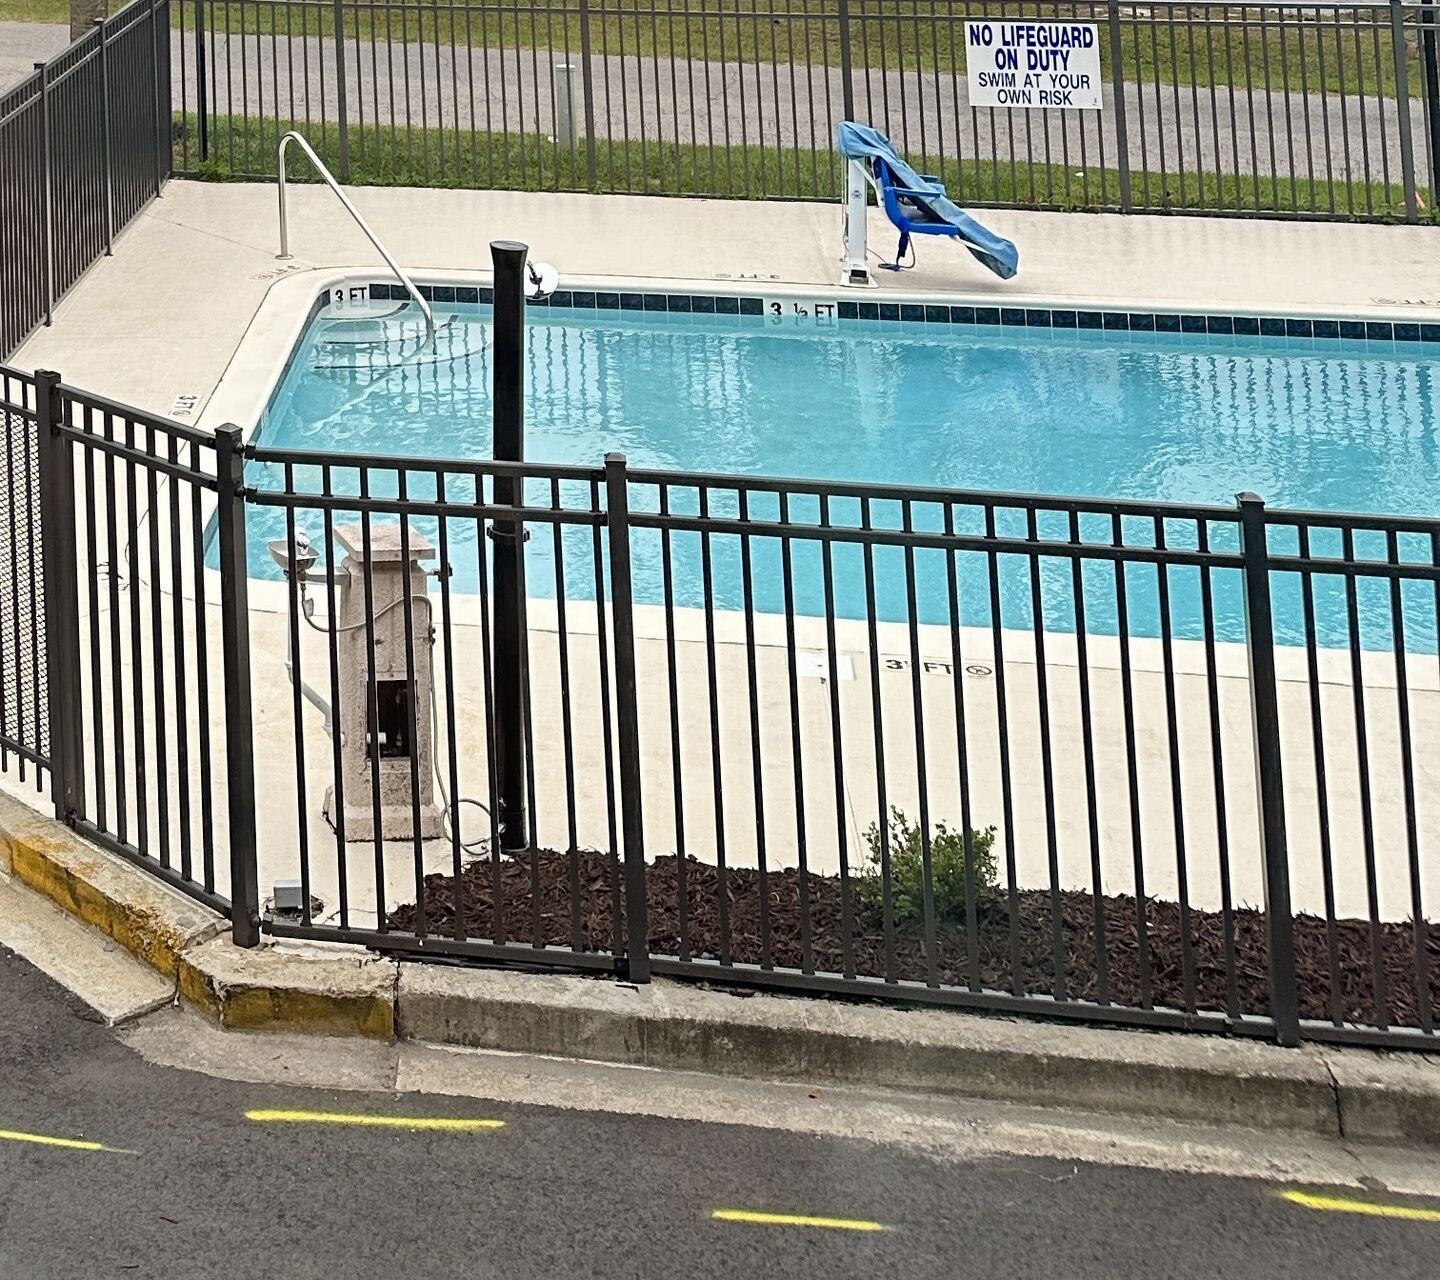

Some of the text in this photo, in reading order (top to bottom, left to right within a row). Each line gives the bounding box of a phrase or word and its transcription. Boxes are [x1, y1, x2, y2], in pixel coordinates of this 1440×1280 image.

[969, 24, 1093, 48] NO LIFEGUARD
[995, 48, 1070, 71] ON DUTY
[978, 72, 1090, 90] SWIM AT YOUR
[997, 89, 1073, 105] OWN RISK
[335, 287, 367, 301] 3 FT
[770, 302, 782, 316] 3
[815, 304, 835, 318] FT
[923, 662, 953, 675] FT
